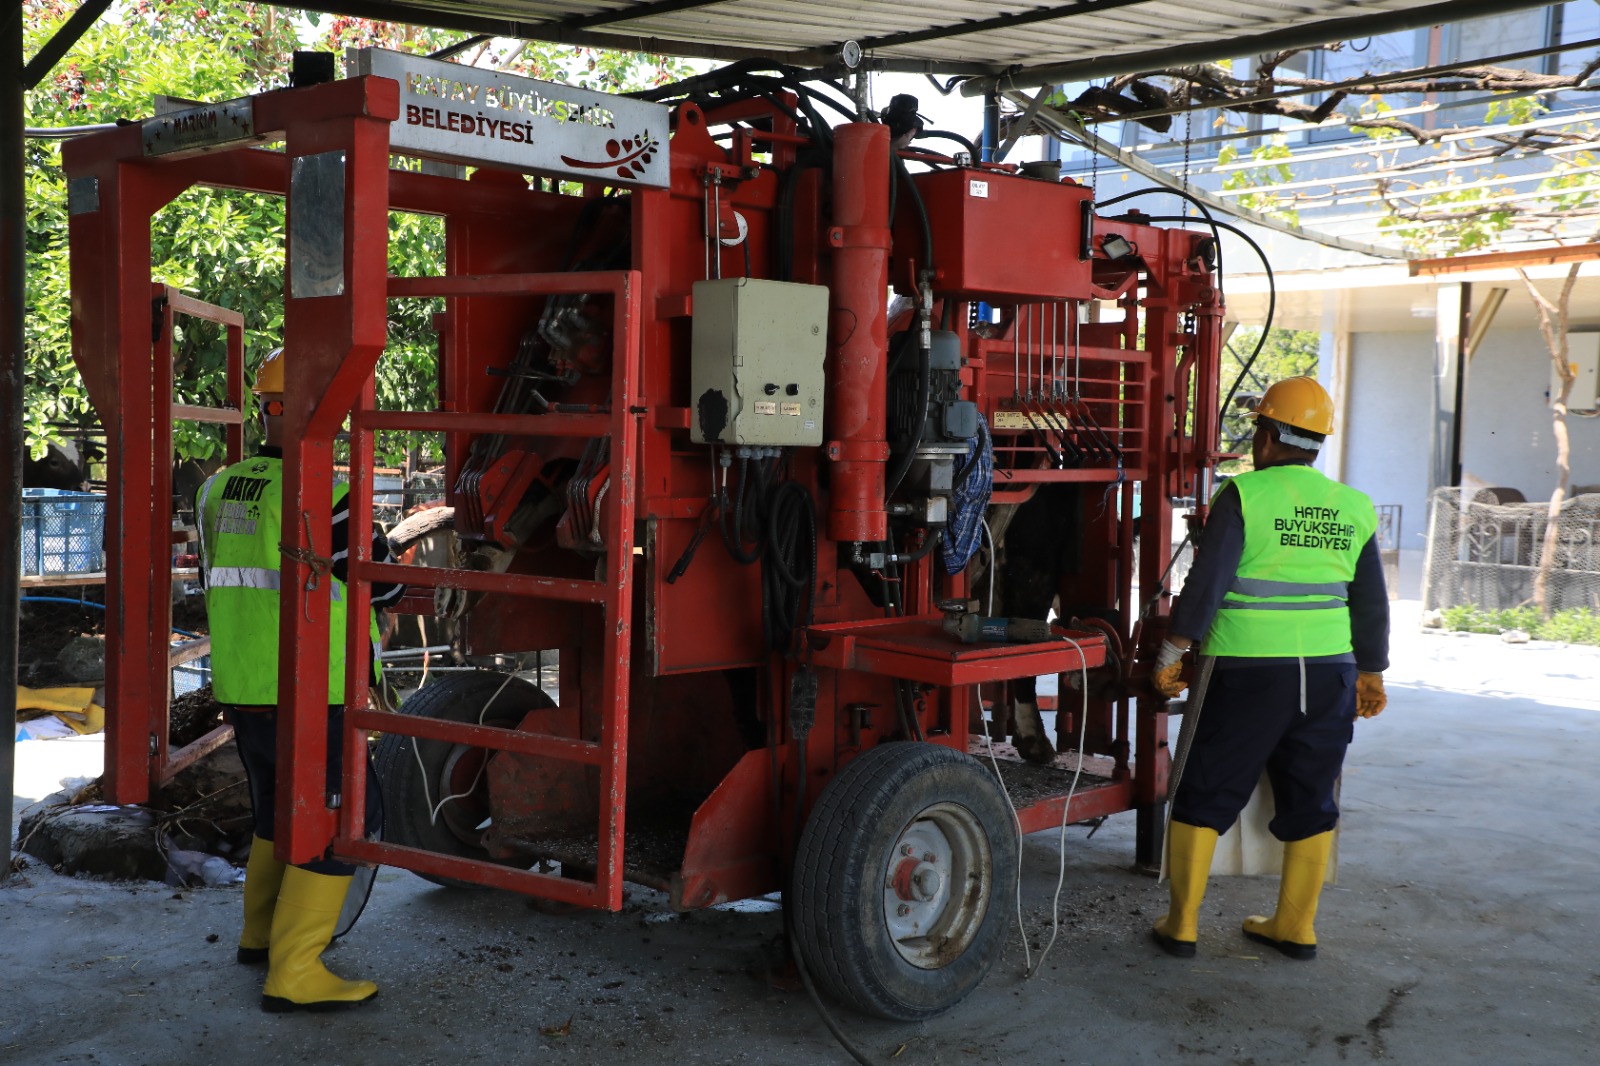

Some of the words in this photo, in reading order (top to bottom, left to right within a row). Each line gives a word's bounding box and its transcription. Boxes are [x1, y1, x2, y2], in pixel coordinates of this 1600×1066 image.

[406, 71, 480, 104] HATAY
[485, 85, 615, 129] BÜYÜKŞEHİR
[407, 104, 534, 144] BELEDİYESİ
[221, 476, 272, 502] HATAY
[1294, 506, 1340, 521] HATAY
[1280, 533, 1352, 551] BELEDİYESİ
